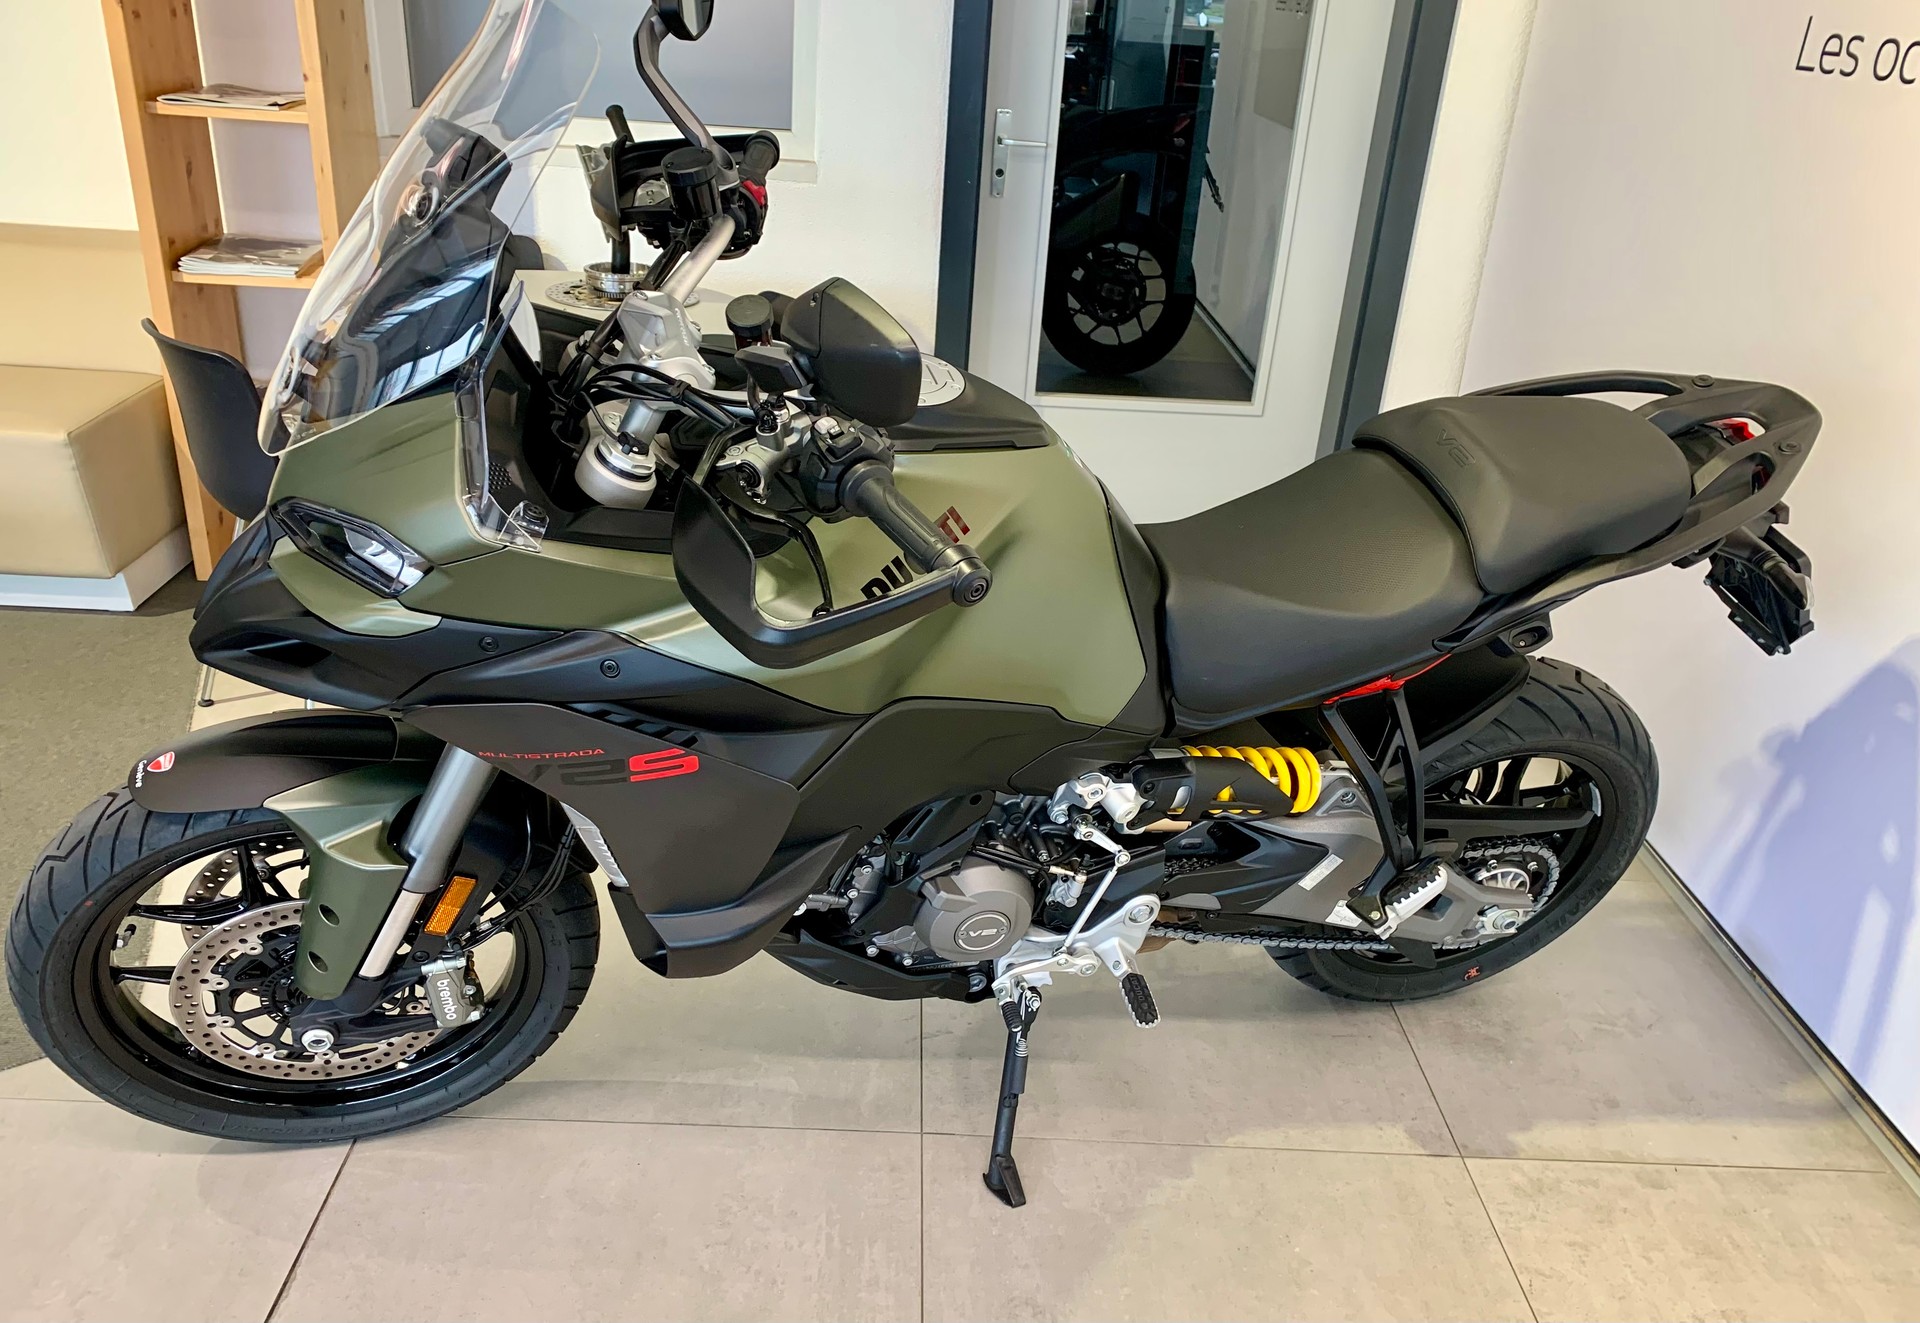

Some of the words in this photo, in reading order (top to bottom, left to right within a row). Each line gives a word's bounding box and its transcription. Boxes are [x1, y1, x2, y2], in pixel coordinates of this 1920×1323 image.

[1795, 15, 1865, 77] Les
[478, 748, 605, 759] MULTISTRADA
[968, 928, 998, 937] V2
[436, 978, 458, 1020] brembo
[1130, 974, 1145, 1001] DUCAT
